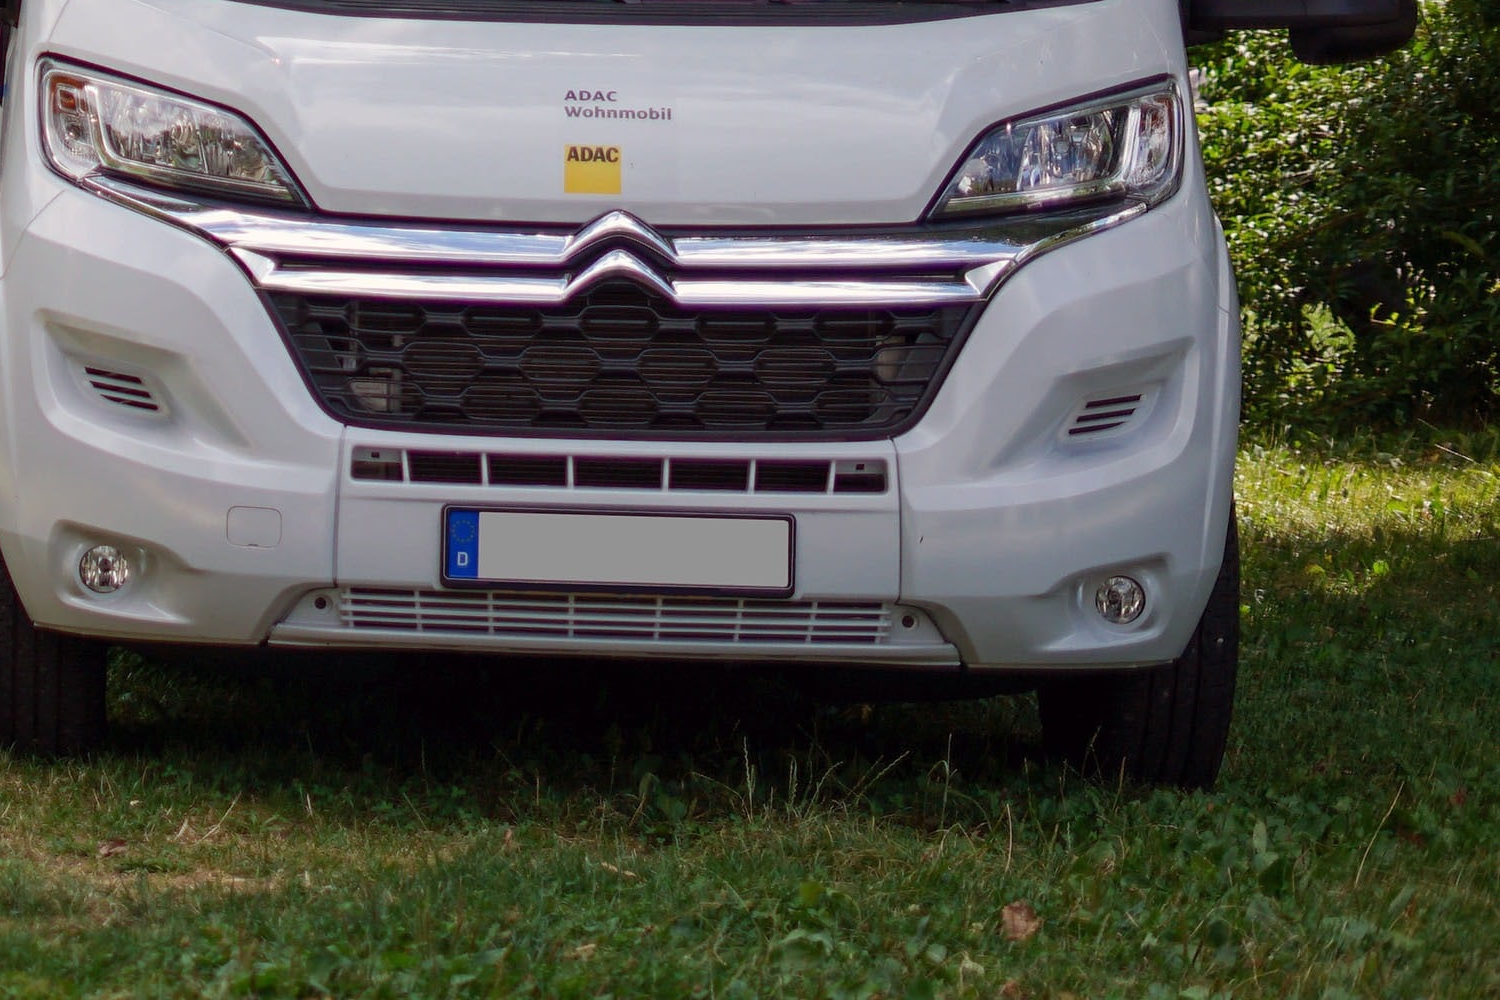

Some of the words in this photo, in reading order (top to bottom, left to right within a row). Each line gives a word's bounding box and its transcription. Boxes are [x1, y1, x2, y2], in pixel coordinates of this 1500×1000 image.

[564, 90, 618, 102] ADAC
[564, 106, 672, 121] Wohnmobil
[567, 146, 619, 163] ADAC
[457, 551, 469, 566] D
